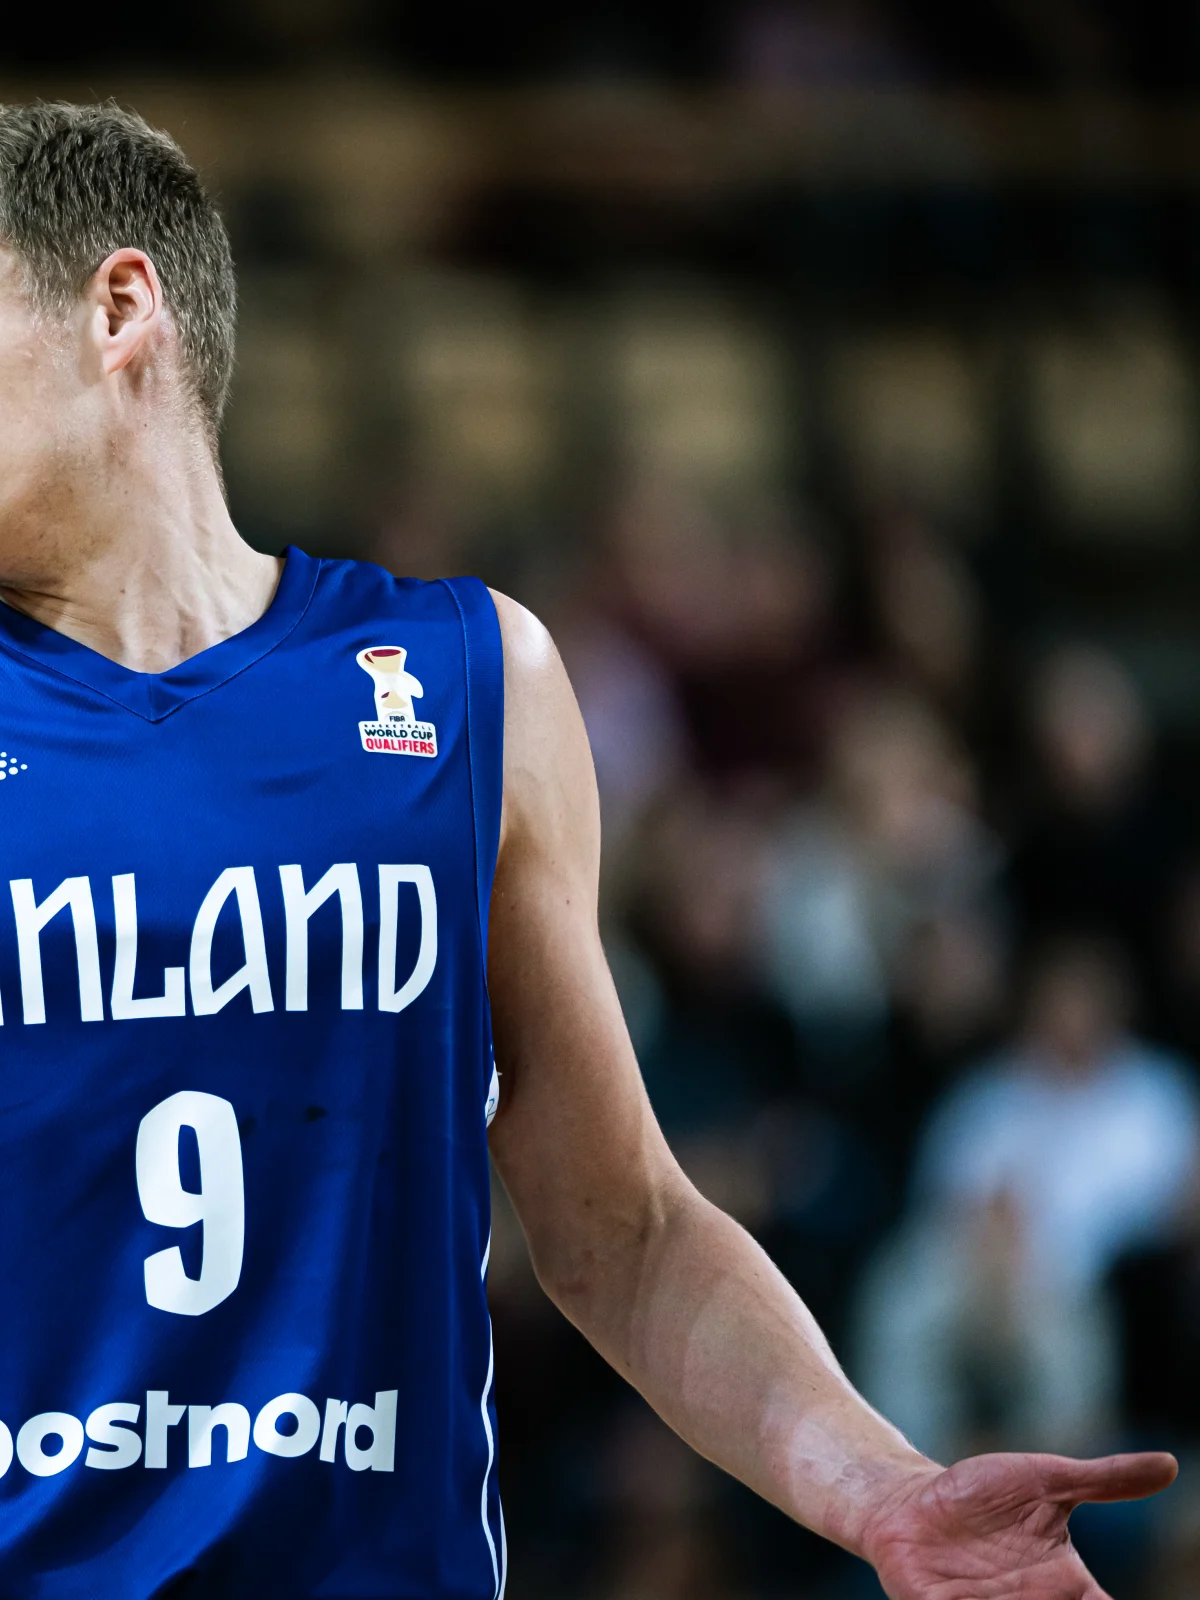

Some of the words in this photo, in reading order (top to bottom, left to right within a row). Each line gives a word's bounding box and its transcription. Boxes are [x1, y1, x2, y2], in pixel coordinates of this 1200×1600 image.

[364, 729, 408, 738] WORLD
[411, 730, 433, 740] CUP
[365, 738, 435, 755] QUALIFIERS
[136, 1091, 244, 1315] 9
